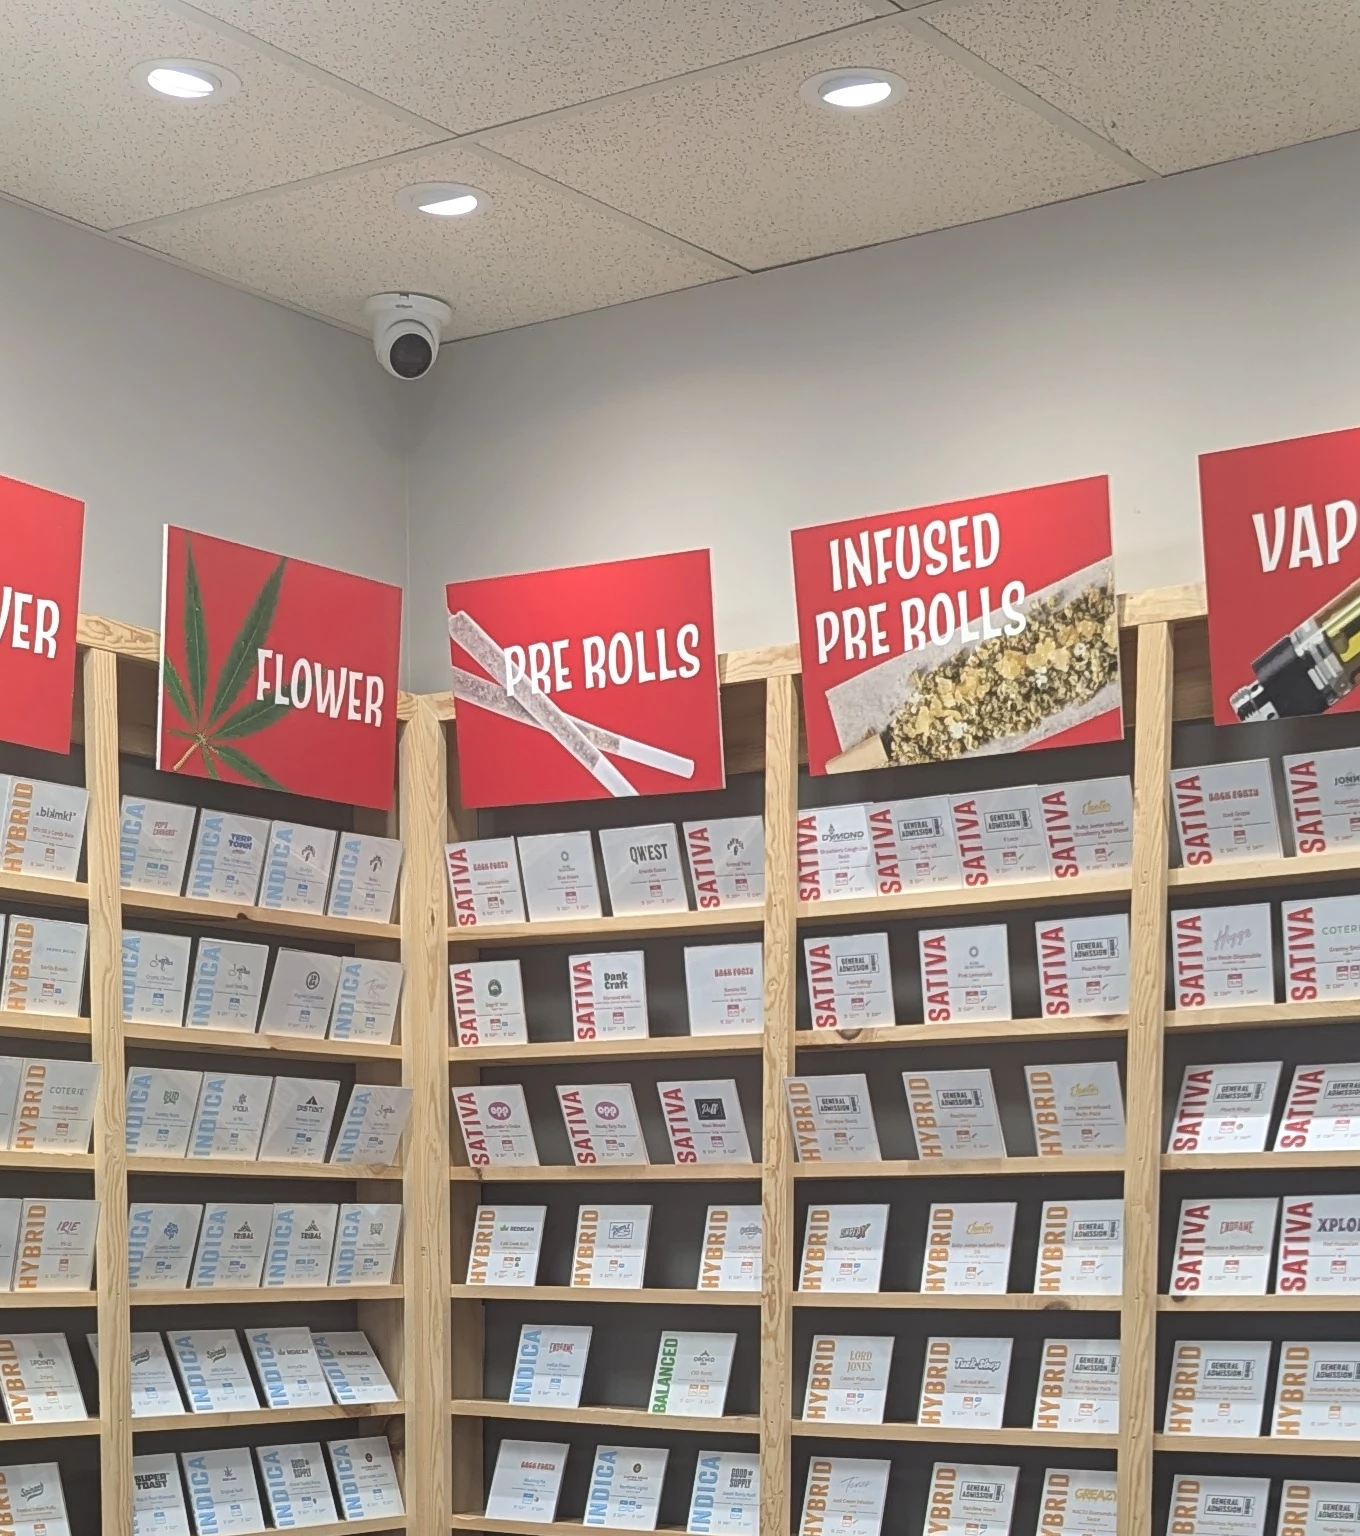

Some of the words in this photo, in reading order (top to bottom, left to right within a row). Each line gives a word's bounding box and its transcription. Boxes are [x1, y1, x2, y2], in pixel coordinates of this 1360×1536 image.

[828, 511, 1001, 592] INFUSED
[502, 638, 573, 697] PRE
[582, 623, 701, 690] ROLLS
[815, 601, 891, 665] PRE
[901, 580, 1028, 652] ROLLS
[256, 647, 385, 728] FLOWER
[822, 830, 865, 843] DYMOND
[953, 799, 989, 886] SATIVA
[988, 820, 1022, 830] ADMISSION
[989, 812, 1016, 823] GENERAL
[572, 960, 596, 1040] SATIVA
[603, 971, 628, 982] Dank
[604, 980, 629, 990] Craft
[174, 1335, 214, 1412] INDICA
[652, 1337, 679, 1414] BALANCED
